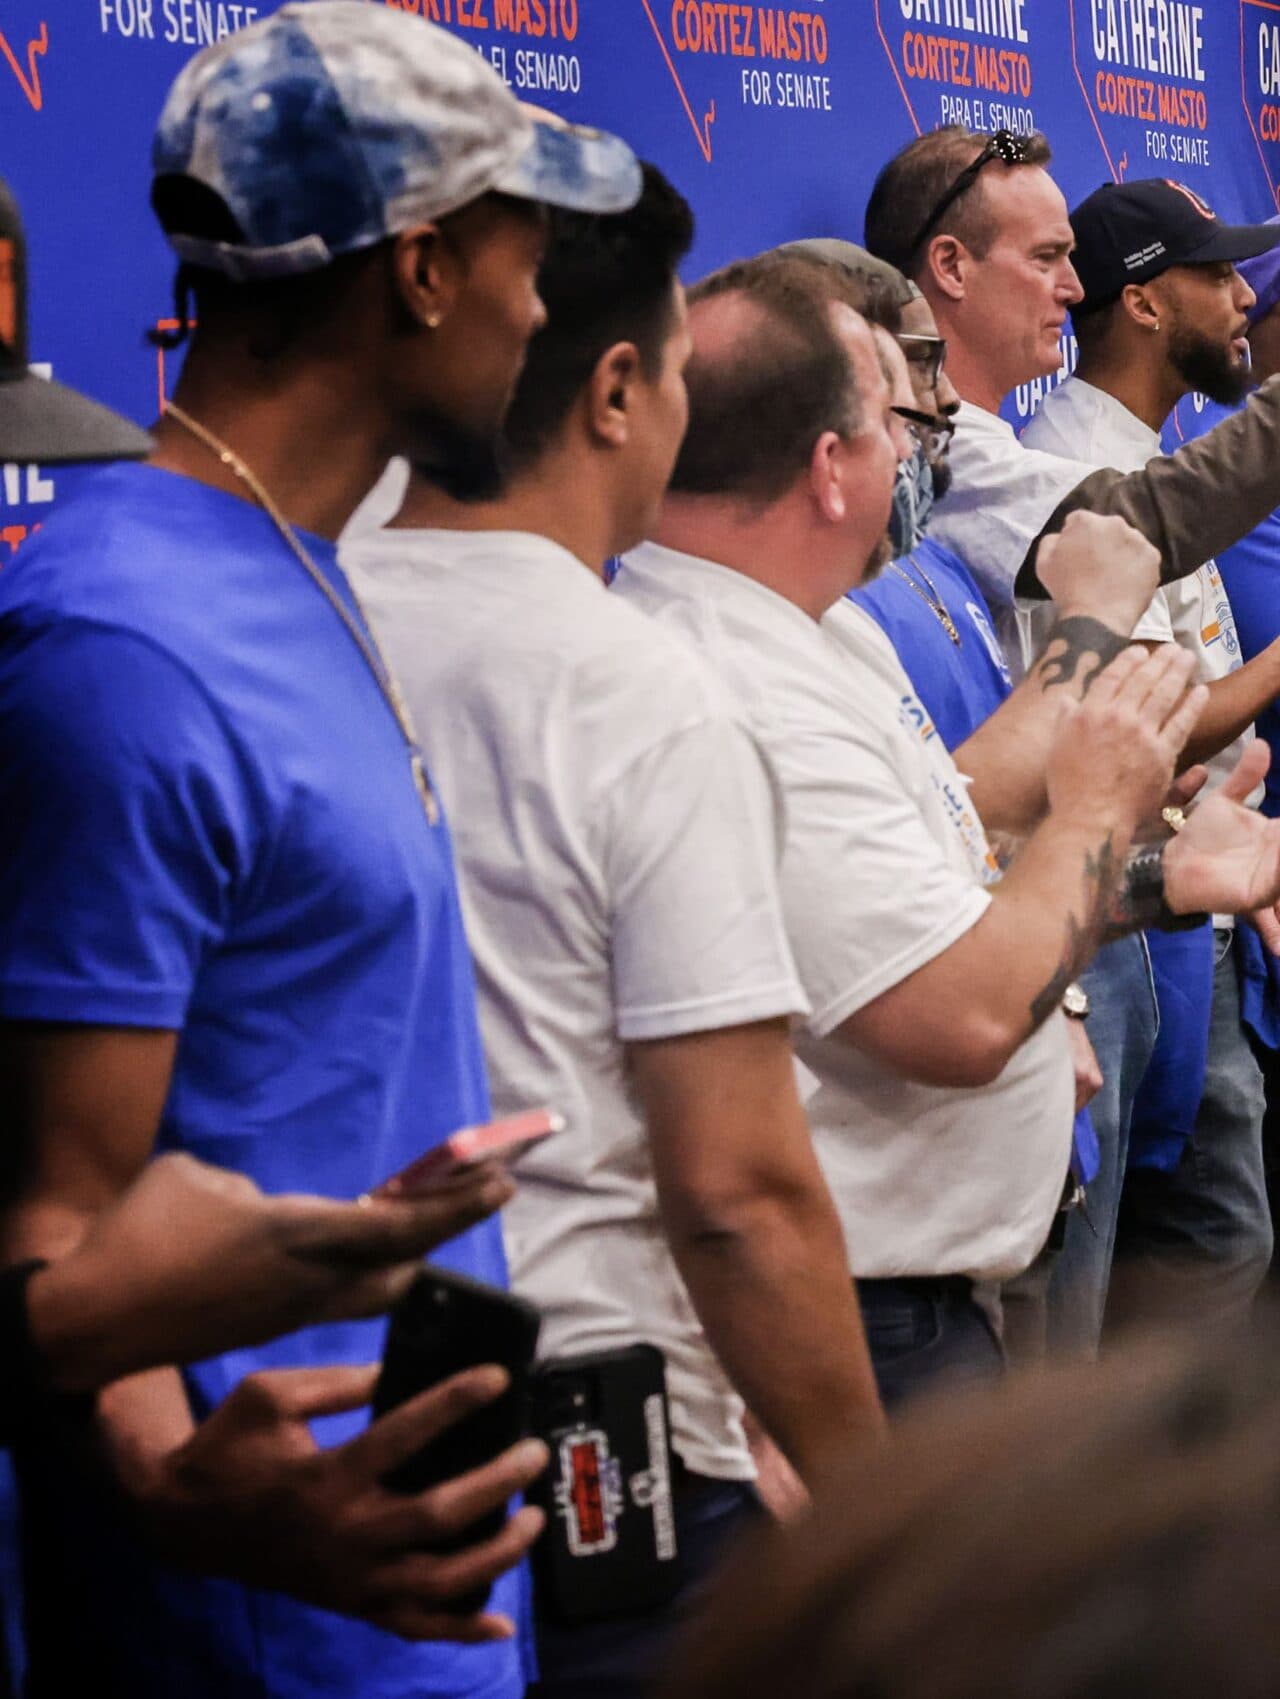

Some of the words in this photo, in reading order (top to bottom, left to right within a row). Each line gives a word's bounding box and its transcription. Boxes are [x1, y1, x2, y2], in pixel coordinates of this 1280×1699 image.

[100, 0, 155, 38] FOR
[671, 0, 756, 57] CORTEZ
[757, 7, 828, 65] MASTO
[1091, 0, 1206, 82] CATHERINE
[515, 49, 581, 94] SENADO
[902, 31, 973, 87] CORTEZ
[974, 44, 1032, 99] MASTO
[742, 69, 773, 106] FOR
[776, 71, 832, 111] SENATE
[1095, 70, 1157, 122] CORTEZ
[1157, 83, 1208, 131] MASTO
[941, 94, 973, 129] PARA
[973, 99, 989, 132] EL
[989, 102, 1036, 138] SENADO
[1145, 130, 1168, 161] FOR
[1169, 133, 1211, 167] SENATE
